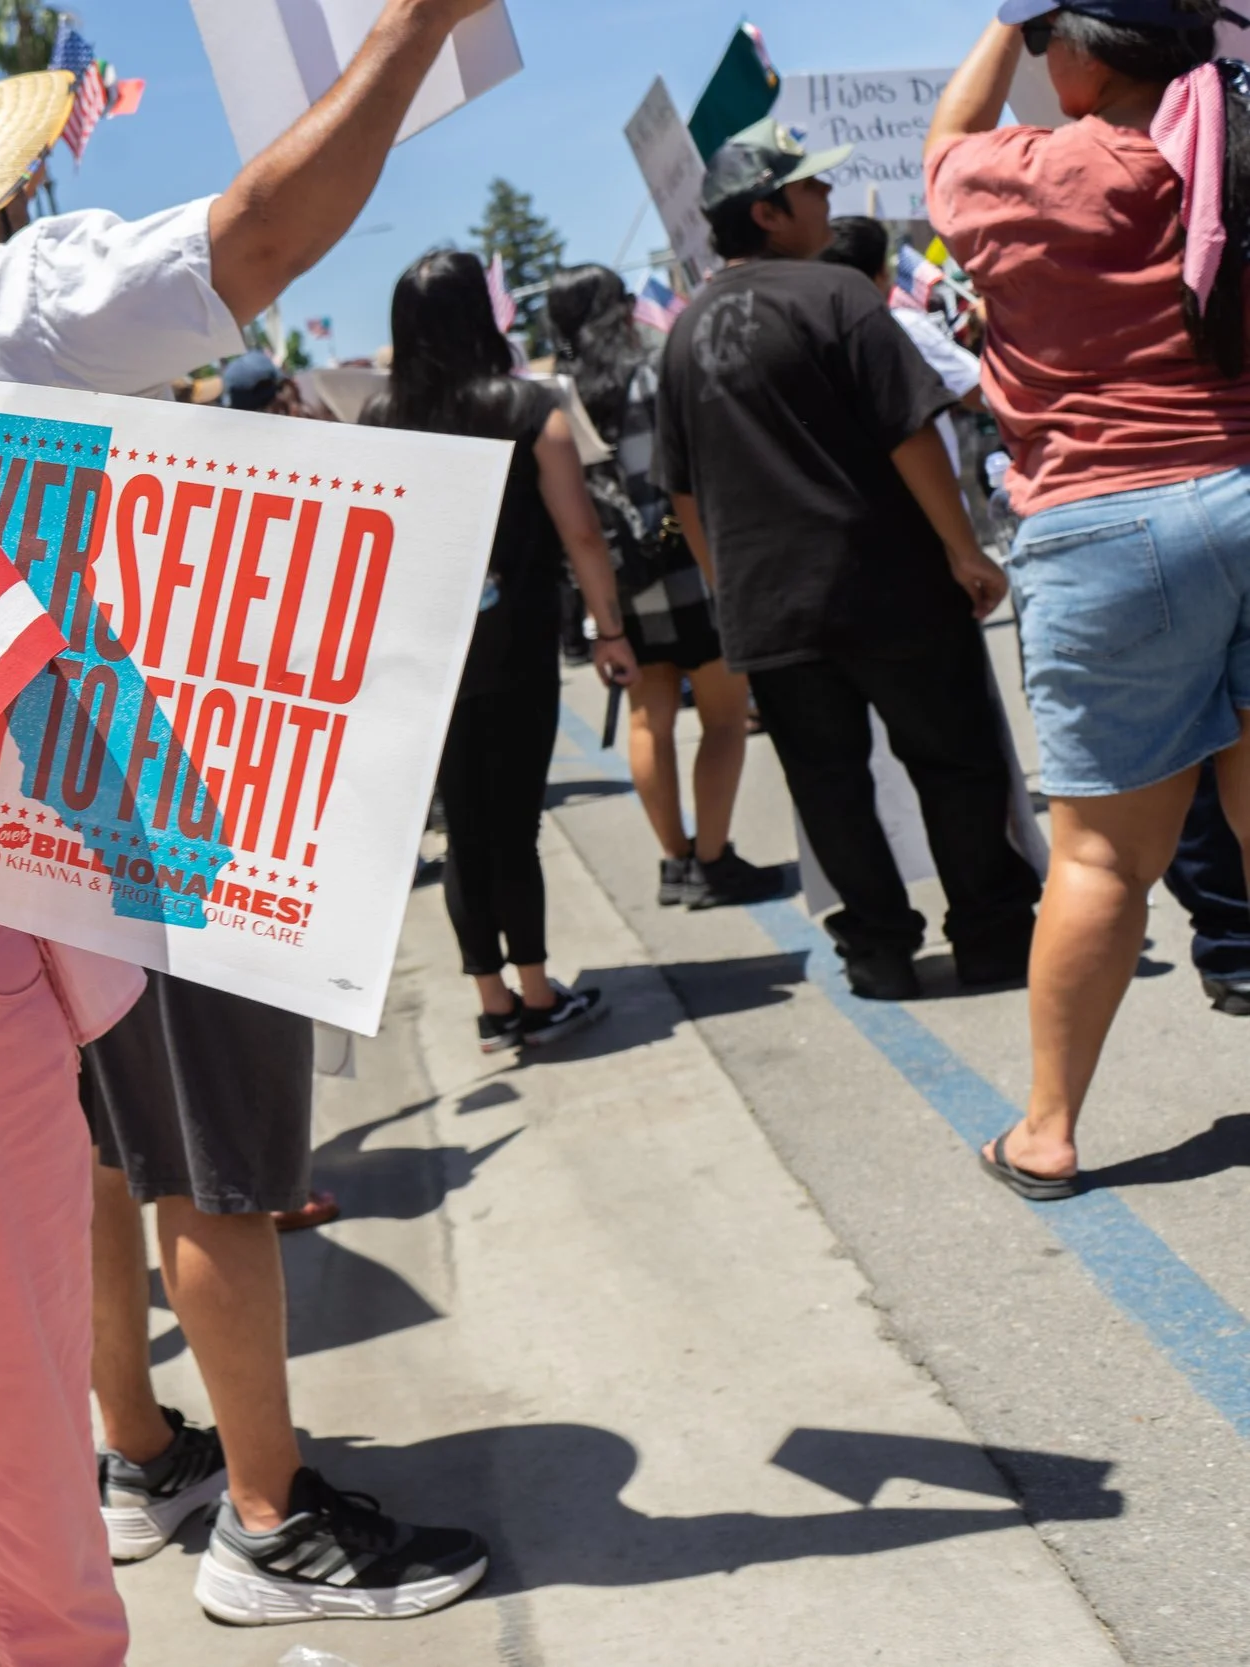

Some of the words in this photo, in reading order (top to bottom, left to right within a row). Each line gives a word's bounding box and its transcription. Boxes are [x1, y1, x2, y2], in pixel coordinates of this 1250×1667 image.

[31, 657, 119, 811] TO
[117, 675, 348, 868] FIGHT!
[6, 854, 82, 887] KHANNA
[88, 876, 102, 892] &
[108, 880, 197, 917] PROTECT
[205, 907, 246, 931] OUR
[252, 920, 306, 948] CARE
[30, 832, 314, 928] BILLIONAIRES!
